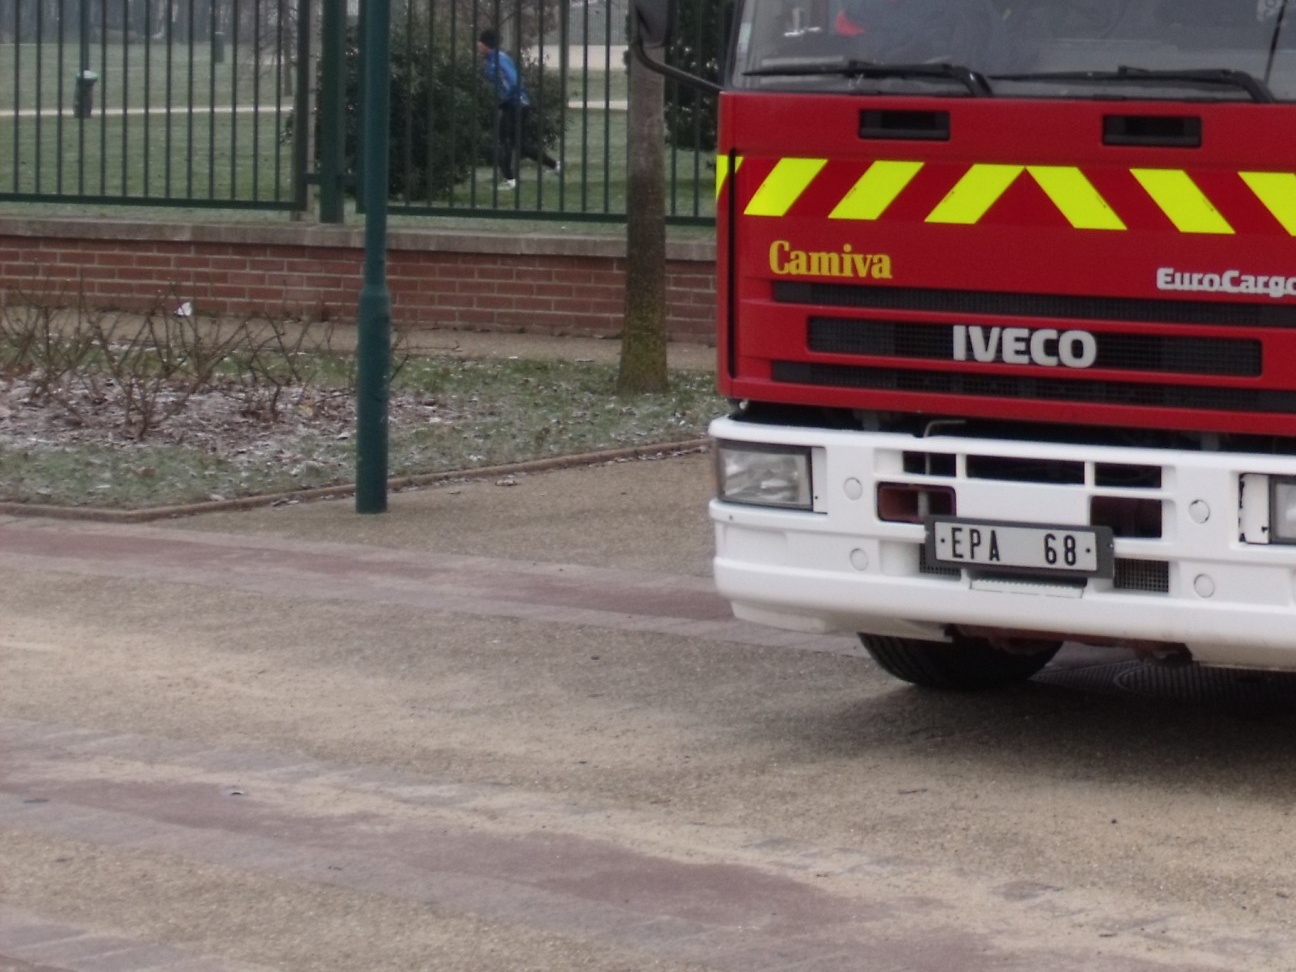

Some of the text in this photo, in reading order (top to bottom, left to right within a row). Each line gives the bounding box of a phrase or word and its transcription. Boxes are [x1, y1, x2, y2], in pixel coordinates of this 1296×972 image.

[769, 239, 893, 280] Camiva
[953, 324, 1098, 369] IVECO
[951, 527, 1077, 567] EPA 68
